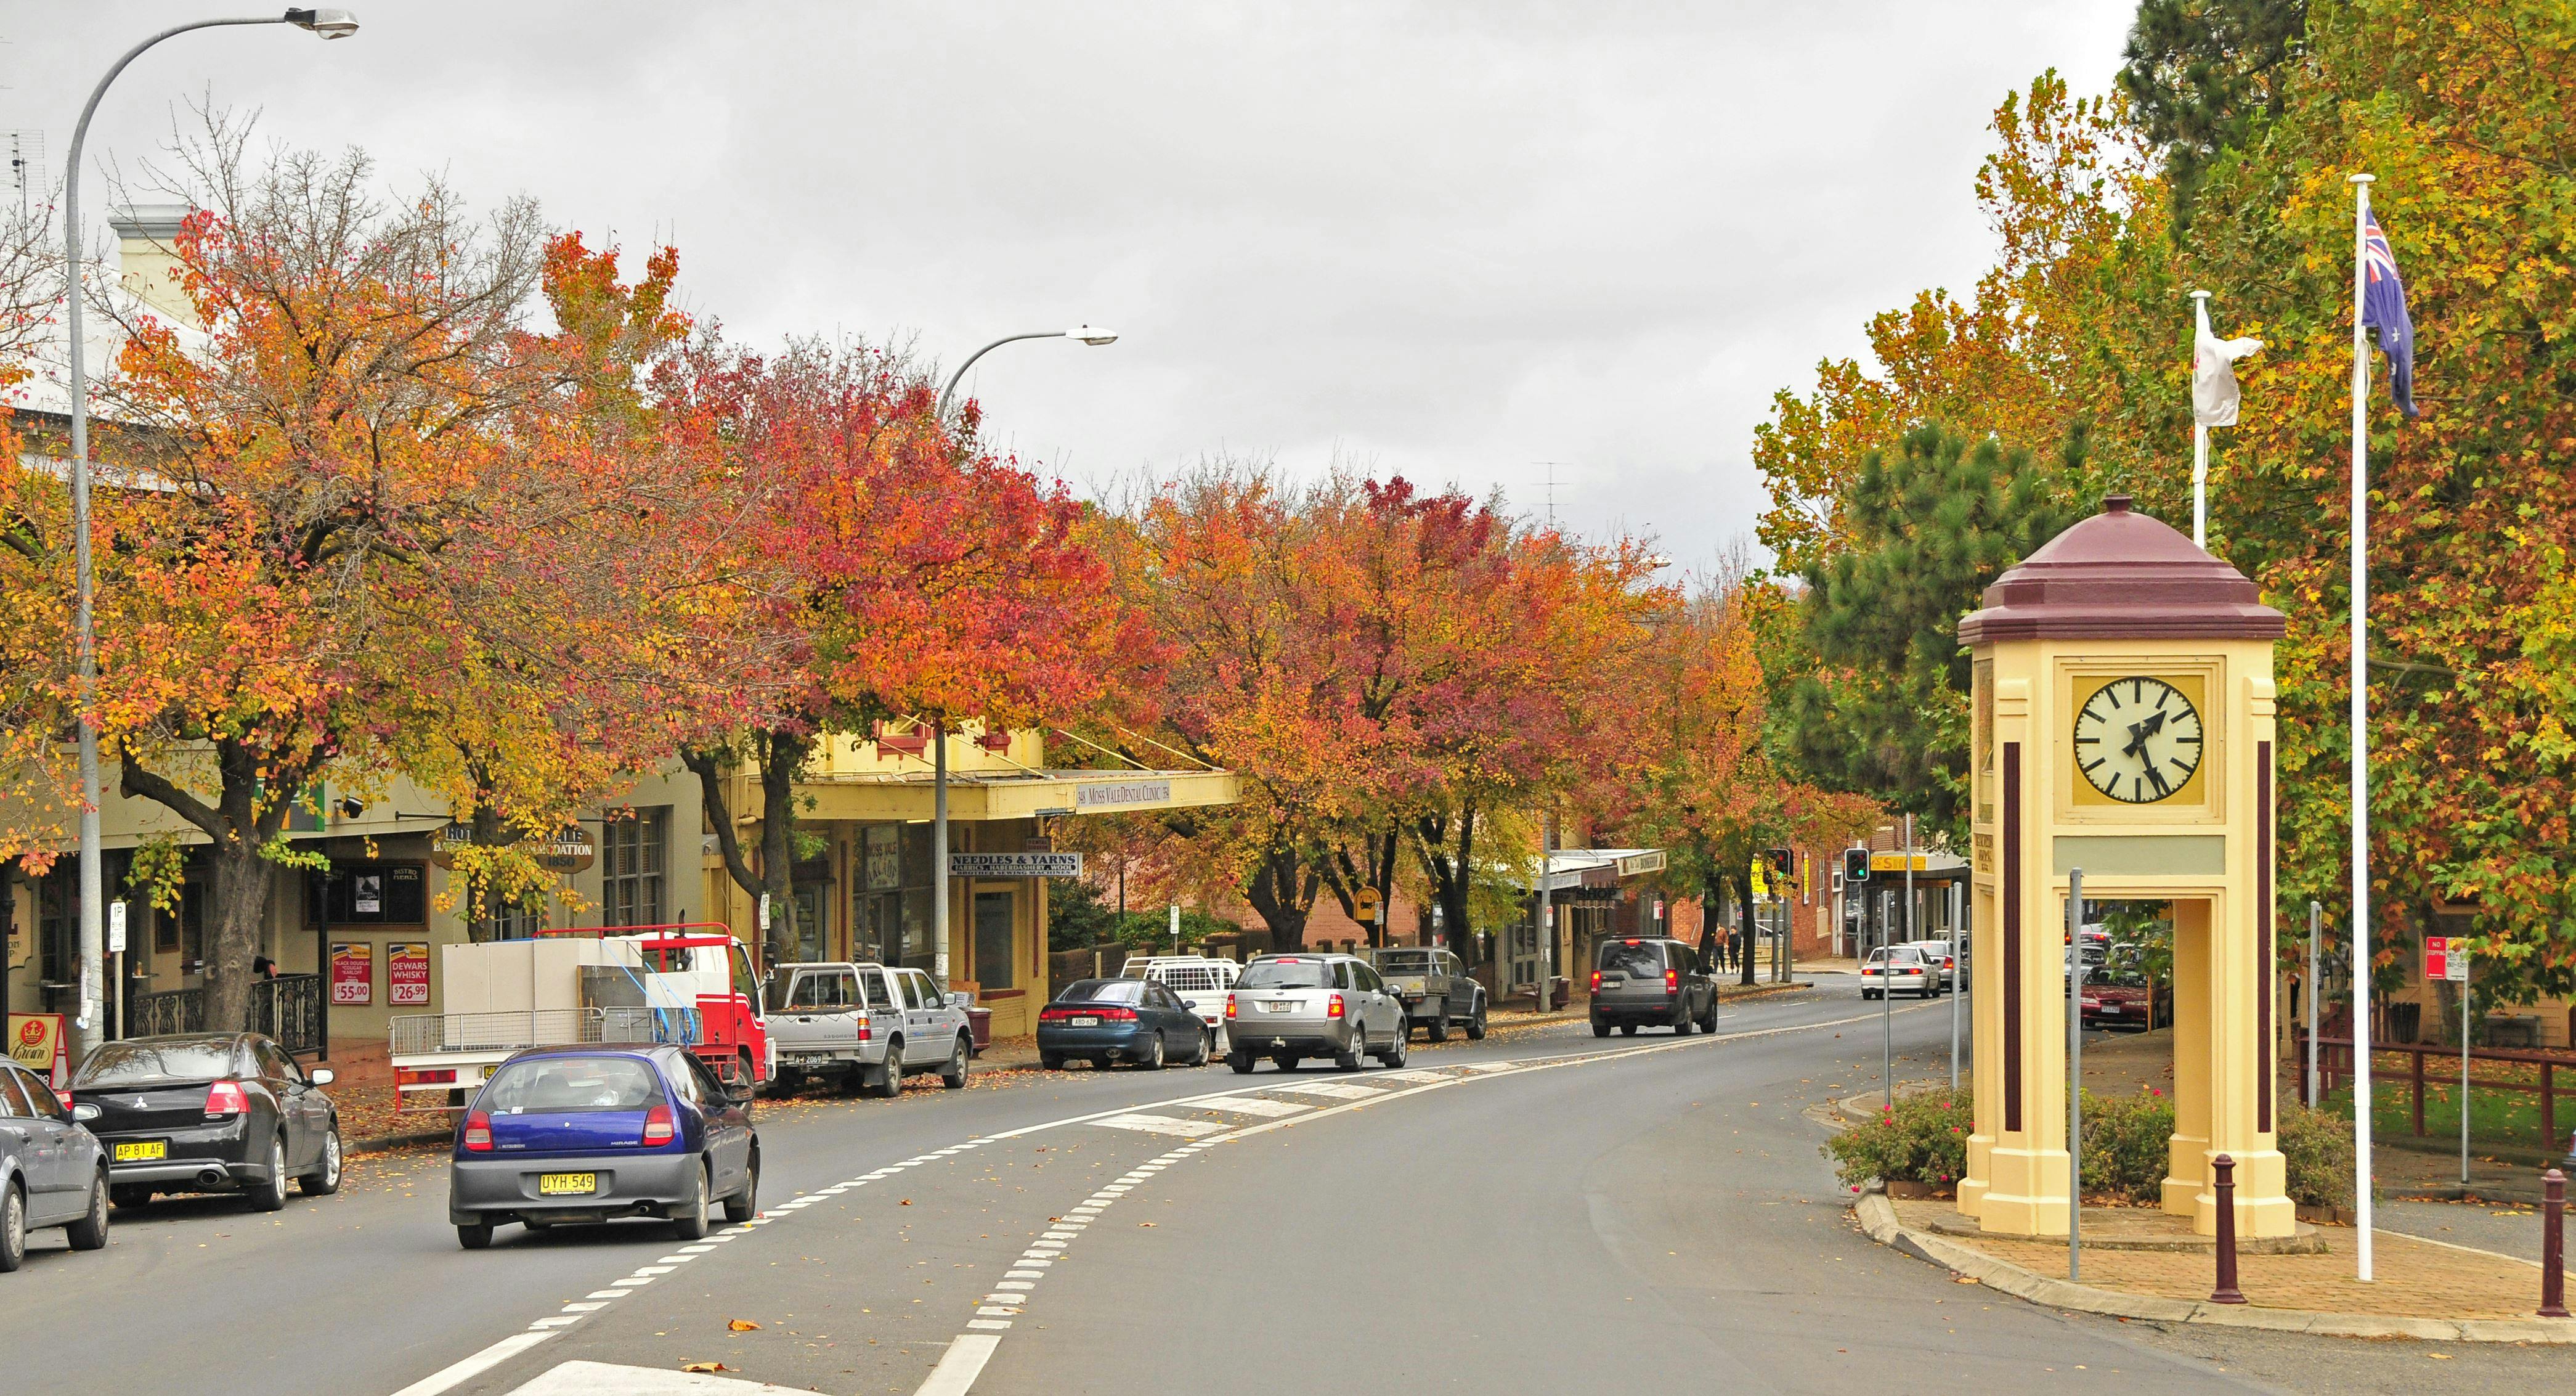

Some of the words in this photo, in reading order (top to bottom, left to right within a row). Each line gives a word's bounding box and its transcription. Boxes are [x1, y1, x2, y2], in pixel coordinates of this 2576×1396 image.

[1106, 787, 1120, 803] VALE
[1121, 786, 1142, 802] DENTAL
[1142, 785, 1160, 801] CLINIC
[547, 857, 575, 867] 1850
[953, 855, 1013, 864] NEEDLES
[1017, 855, 1026, 863] &
[1031, 855, 1076, 863] YARNS
[392, 962, 428, 970] DEWARS
[393, 971, 427, 979] WHISKY
[336, 986, 368, 999] $55.00
[394, 986, 426, 999] $26.99
[13, 1042, 45, 1060] Crown
